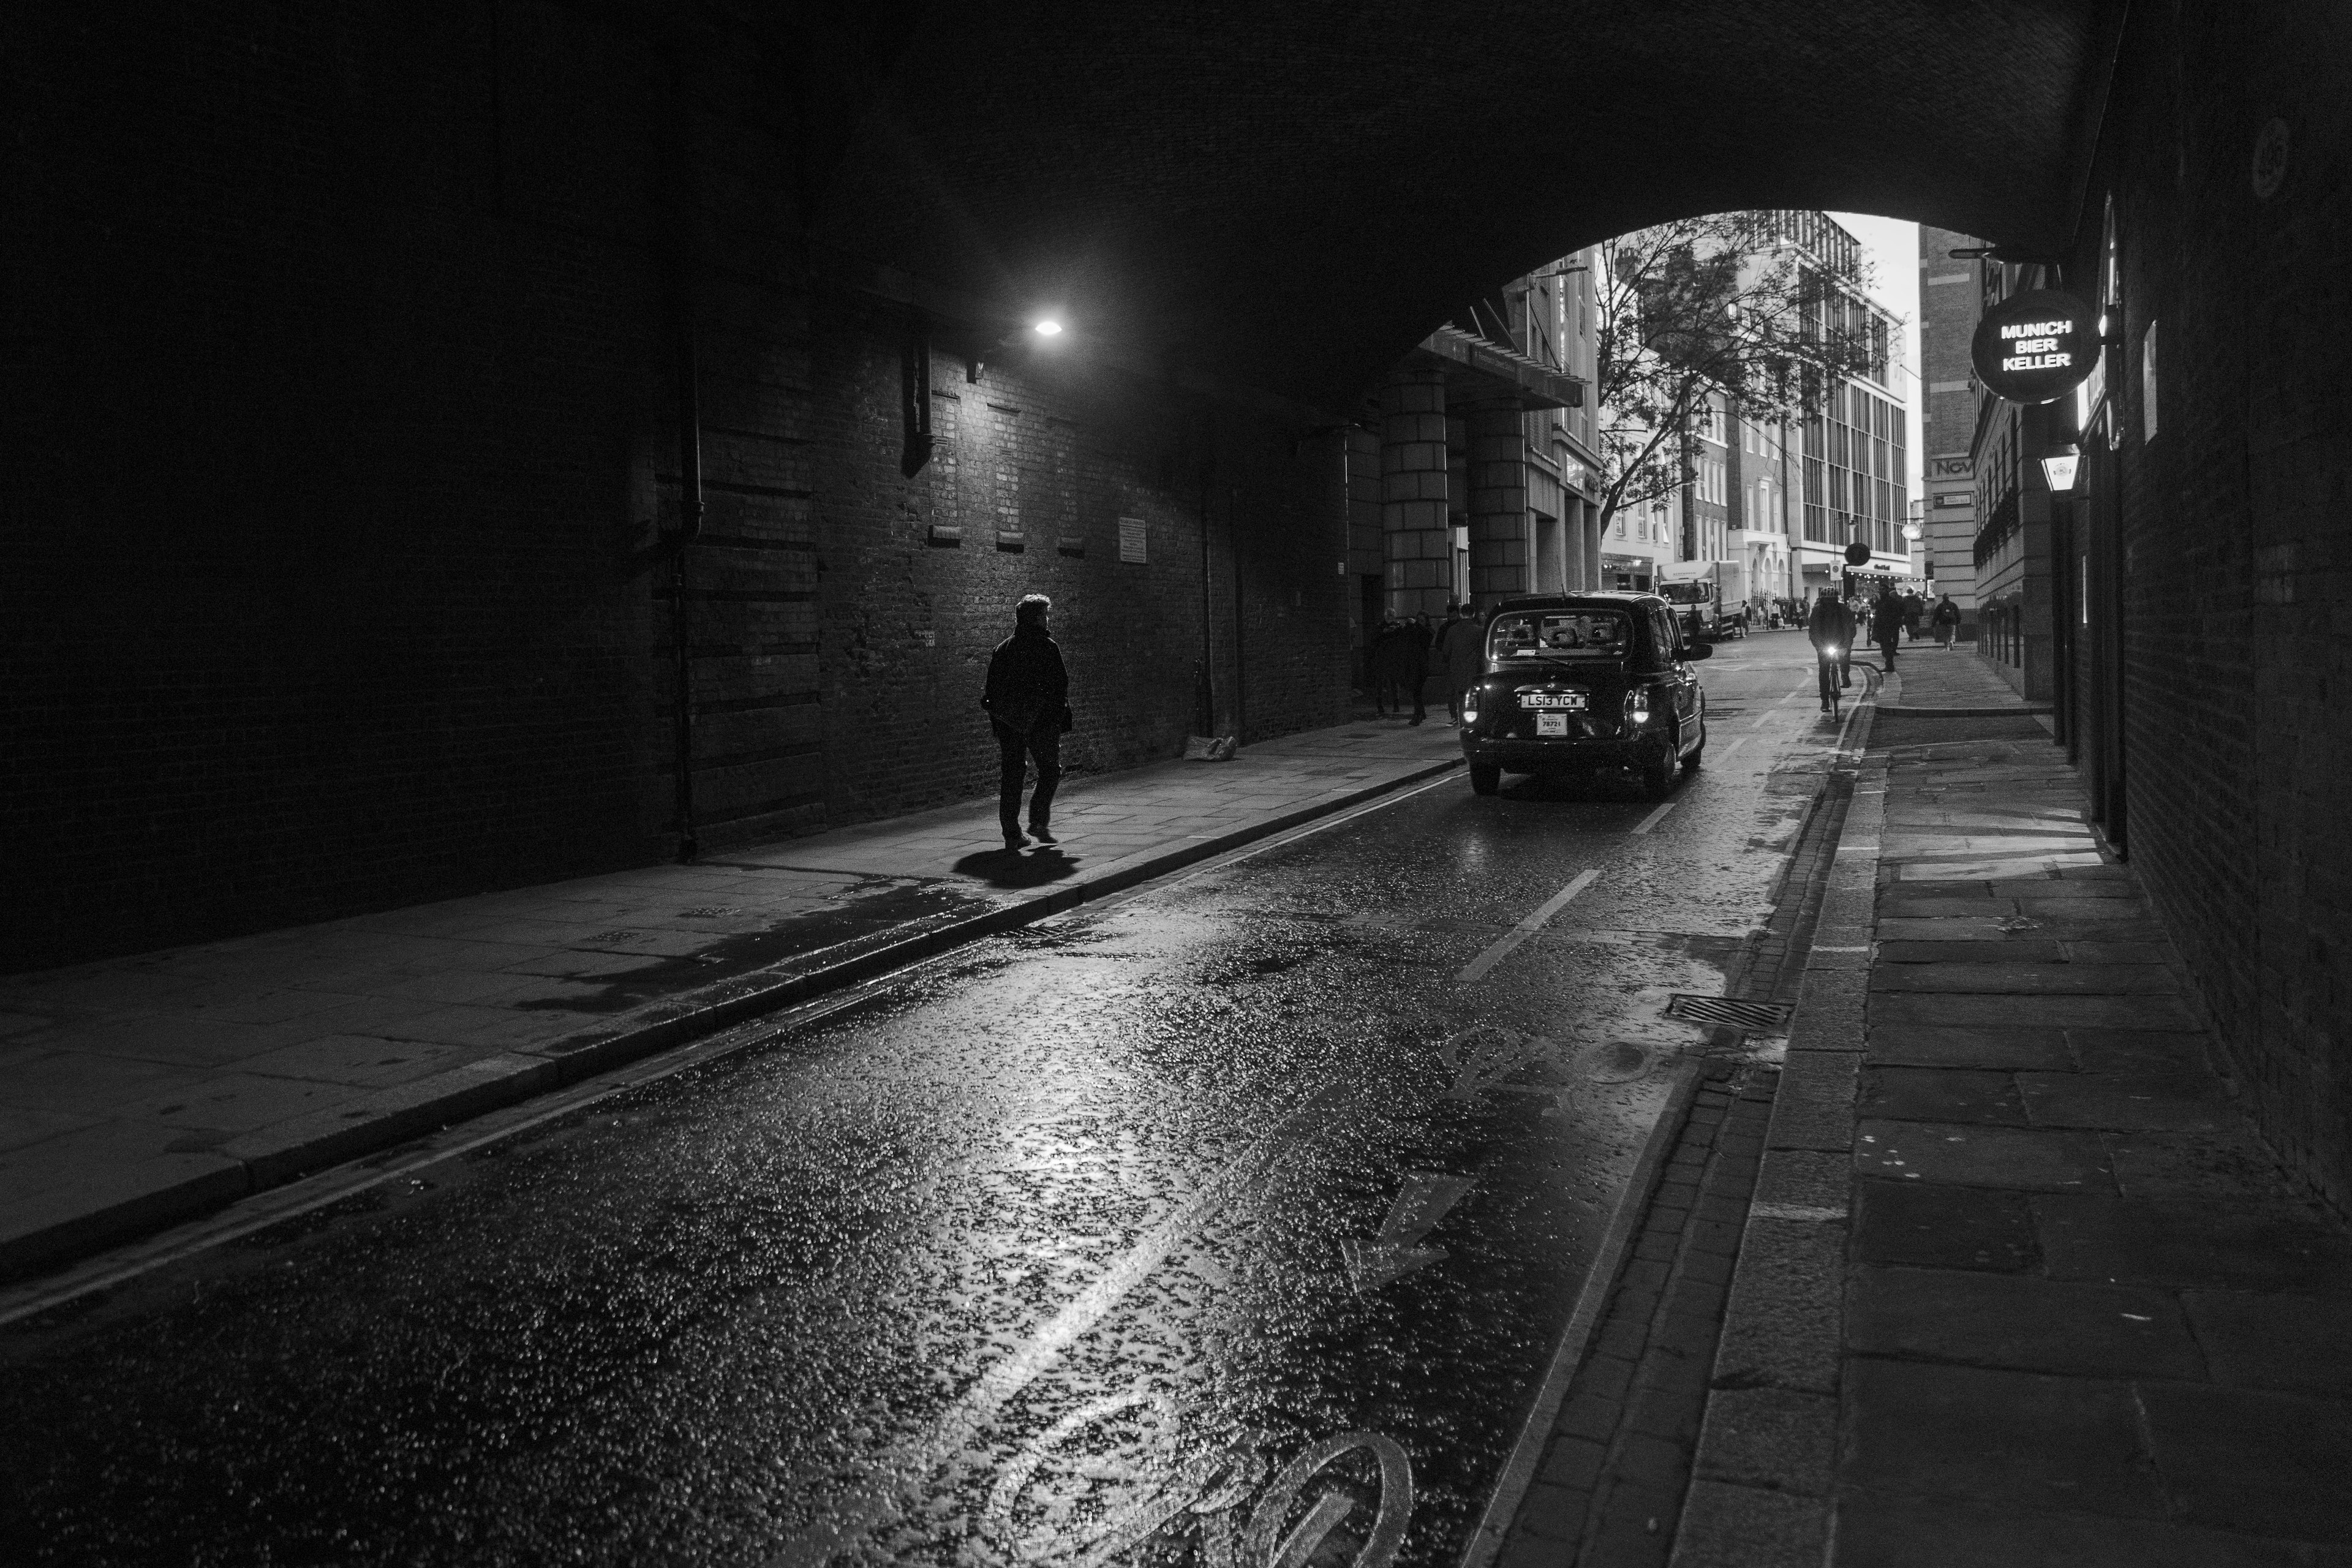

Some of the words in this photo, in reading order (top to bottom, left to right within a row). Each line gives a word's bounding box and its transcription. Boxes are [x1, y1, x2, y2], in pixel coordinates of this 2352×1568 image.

[2000, 320, 2072, 338] MUNICH
[2015, 338, 2058, 353] BIER
[2003, 353, 2071, 371] KELLER
[1528, 696, 1553, 706] LS13
[1555, 696, 1577, 706] YCW
